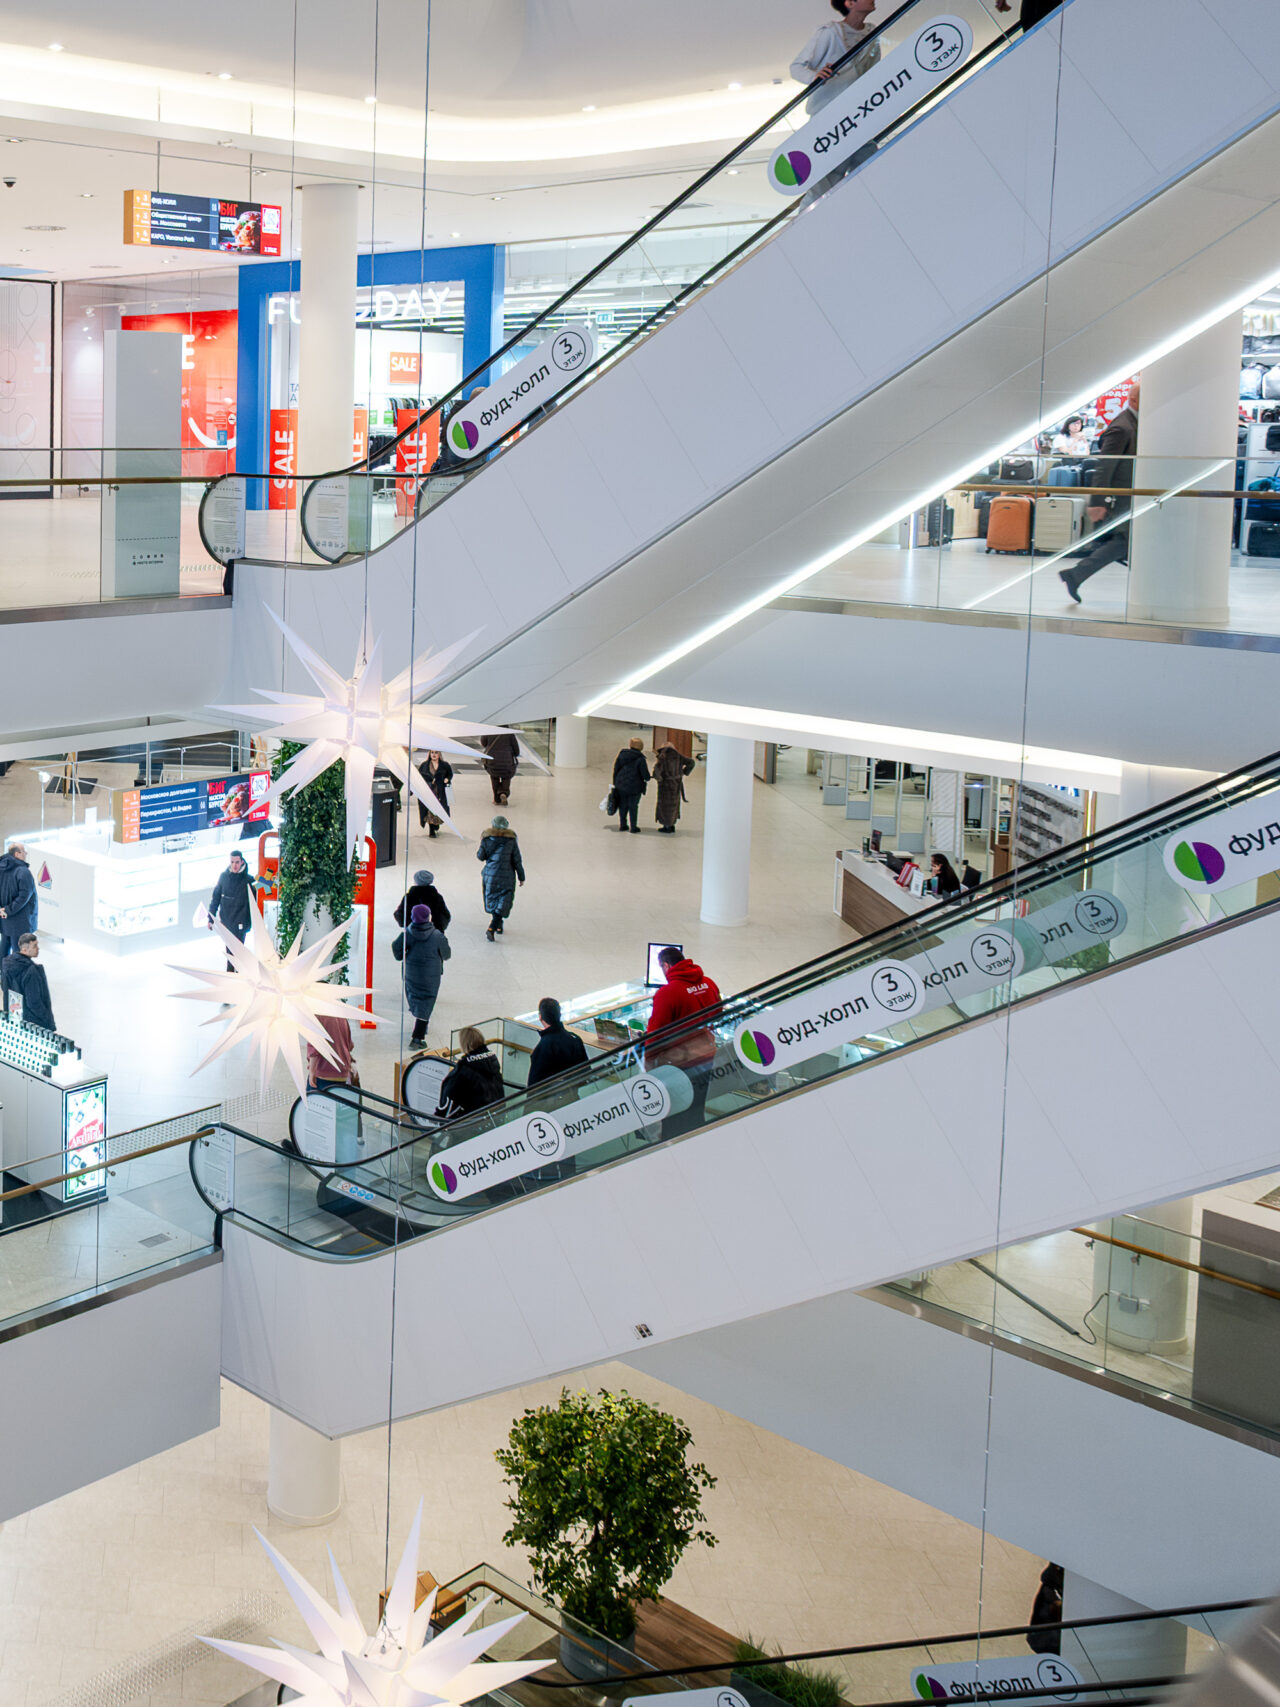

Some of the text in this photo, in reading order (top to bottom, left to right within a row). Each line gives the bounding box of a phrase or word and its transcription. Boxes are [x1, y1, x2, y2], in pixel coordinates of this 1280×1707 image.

[924, 31, 945, 53] 3
[930, 43, 960, 69] этаж
[559, 338, 573, 355] 3
[391, 355, 418, 373] SALE
[563, 350, 583, 368] этаж
[273, 430, 294, 489] SALE
[980, 939, 998, 958] 3
[984, 956, 1012, 972] этаж
[881, 973, 899, 992] 3
[886, 990, 913, 1008] этаж
[638, 1084, 652, 1100] 3
[533, 1123, 547, 1139] 3
[537, 1139, 557, 1152] этаж
[1045, 1664, 1063, 1683] 3
